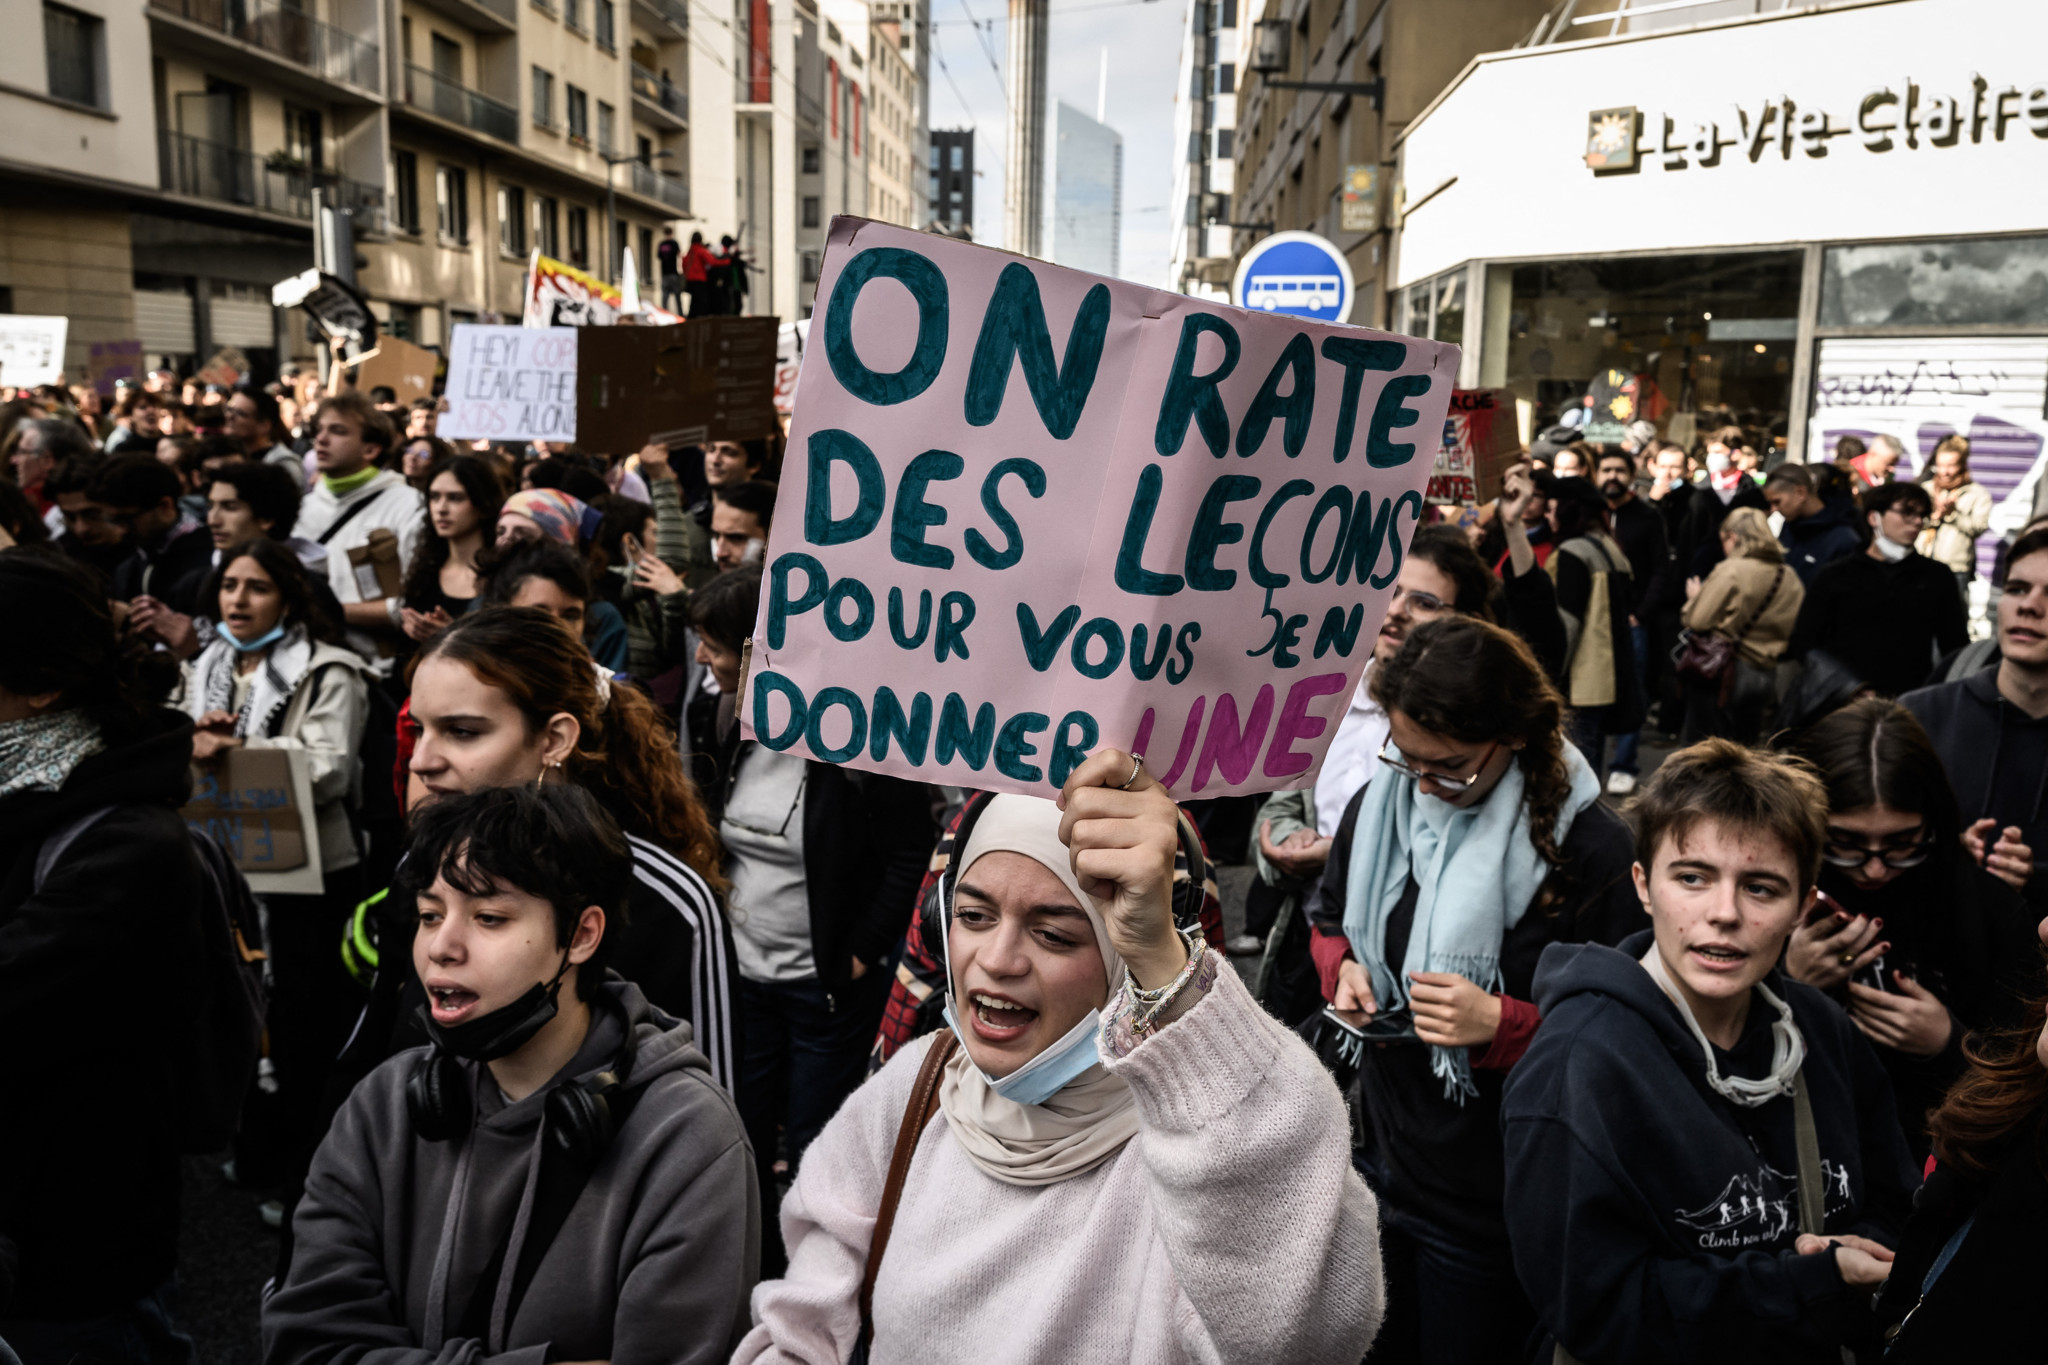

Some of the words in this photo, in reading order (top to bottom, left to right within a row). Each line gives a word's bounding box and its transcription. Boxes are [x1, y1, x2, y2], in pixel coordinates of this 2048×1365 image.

[1654, 112, 1718, 166] La
[1734, 94, 1826, 160] Vie
[1850, 71, 2048, 150] Claire
[464, 368, 533, 402] LEAVE
[536, 369, 577, 404] THE
[823, 246, 1112, 440] ON
[1154, 313, 1432, 469] RATE
[1450, 392, 1494, 411] RCHE
[804, 428, 1047, 570] DES
[1114, 463, 1422, 657] LEÇONS
[767, 551, 976, 663] POUR
[1016, 601, 1202, 685] VOUS
[1273, 602, 1365, 669] EN
[752, 670, 1100, 790] DONNER
[1131, 672, 1347, 794] UNE
[1698, 1229, 1740, 1248] Climb
